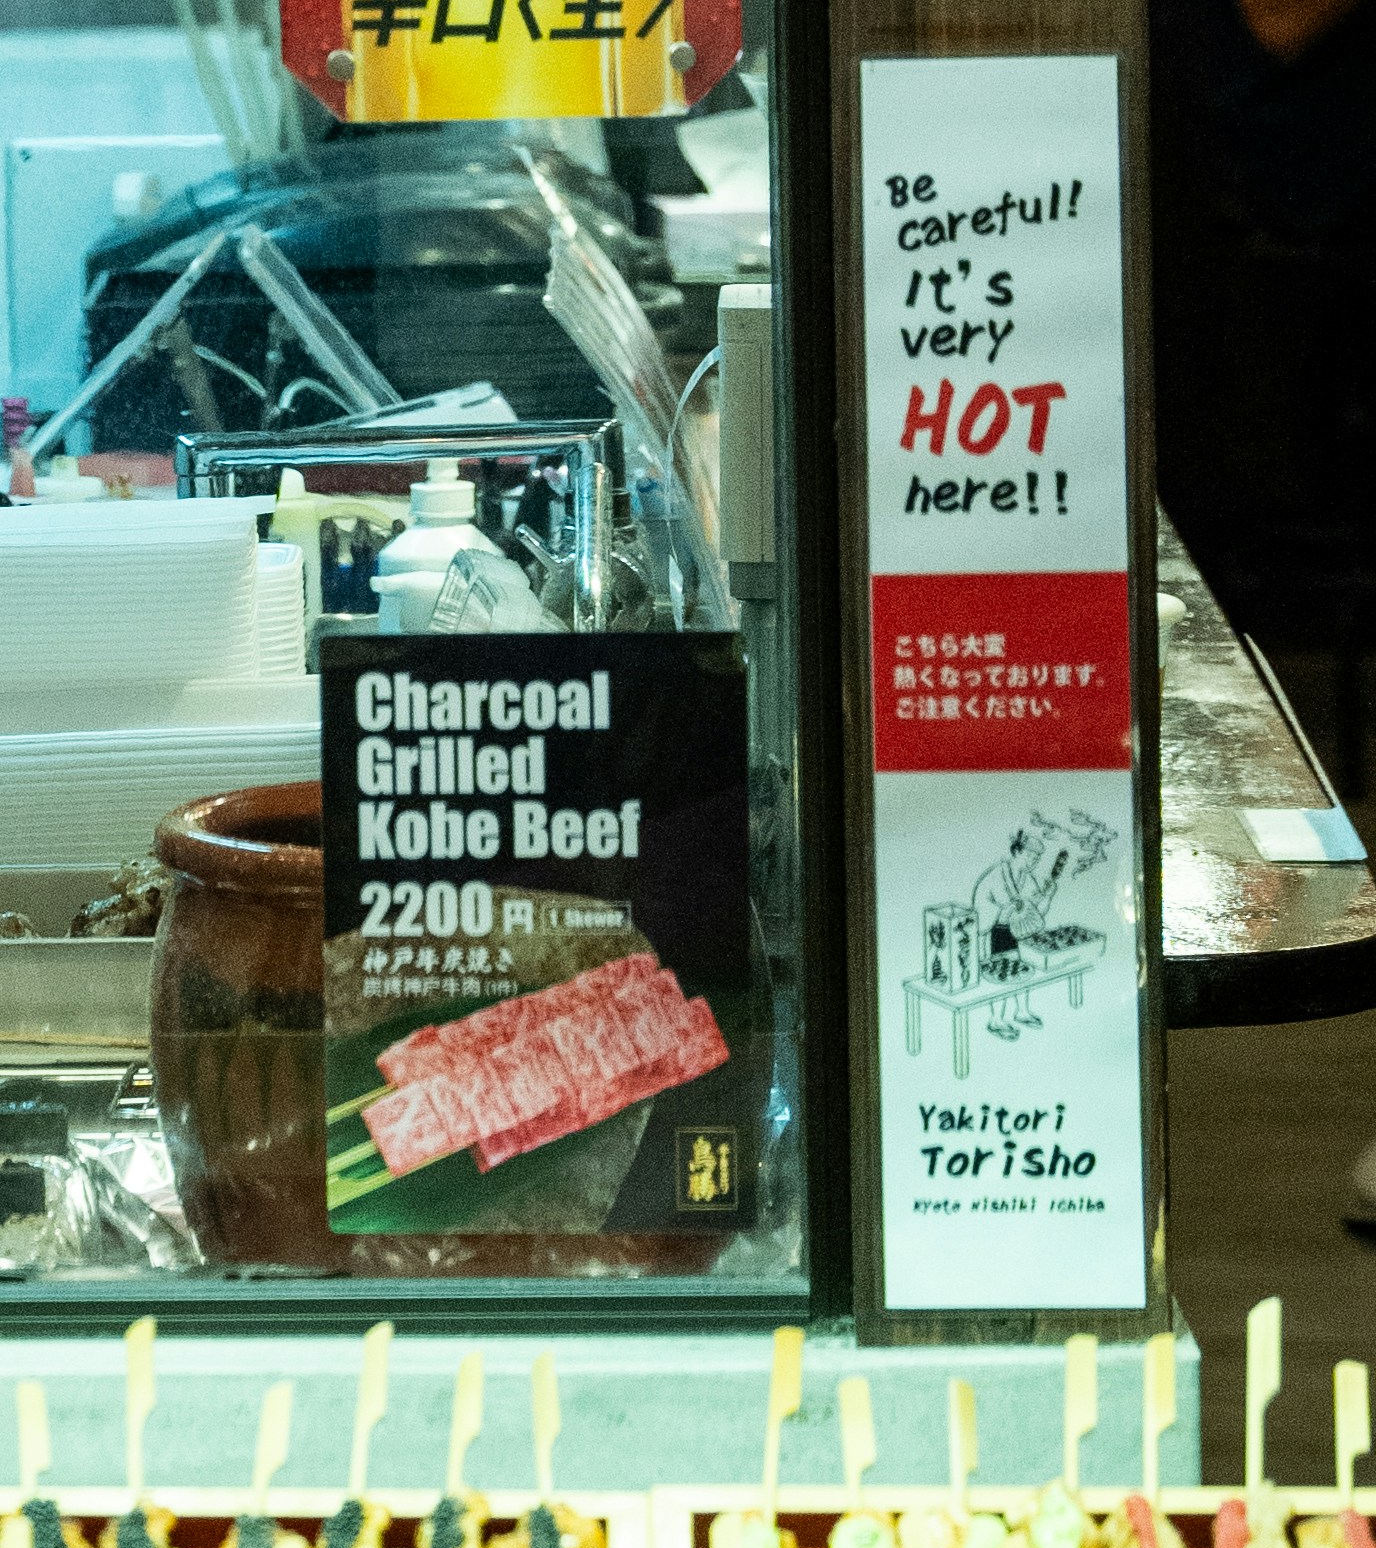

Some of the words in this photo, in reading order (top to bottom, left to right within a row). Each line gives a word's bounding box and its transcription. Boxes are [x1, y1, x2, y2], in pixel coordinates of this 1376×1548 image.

[885, 173, 938, 208] Be
[898, 180, 1082, 251] careful!
[905, 258, 1014, 314] It's
[900, 319, 1014, 364] very
[900, 377, 1066, 456] HOT
[904, 470, 1068, 515] here!!
[895, 633, 1005, 658] こちら大変
[355, 670, 611, 731] Charcoal
[357, 736, 546, 796] Grilled
[359, 800, 500, 860] Kobe
[513, 799, 642, 860] Beef
[360, 880, 493, 938] 2200
[919, 1103, 1065, 1135] Yakitori
[920, 1140, 1096, 1179] Torisho
